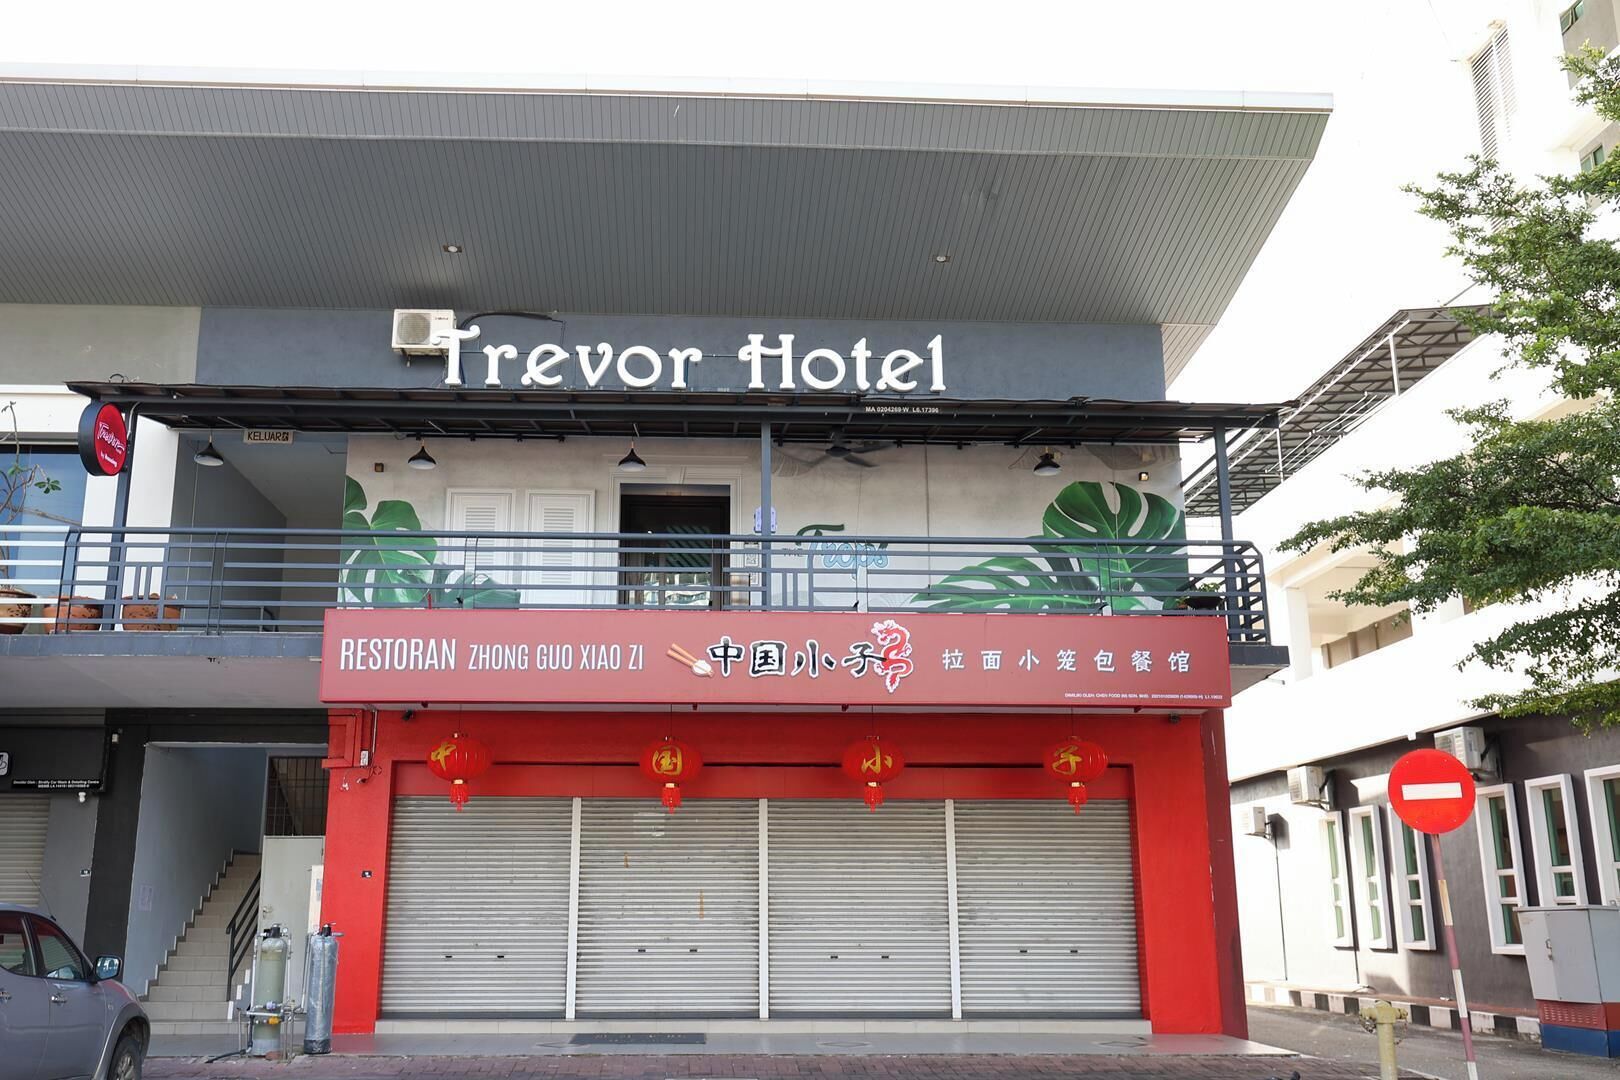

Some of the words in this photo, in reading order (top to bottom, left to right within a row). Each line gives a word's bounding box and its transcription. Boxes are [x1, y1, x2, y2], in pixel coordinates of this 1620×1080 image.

[431, 325, 703, 389] Trevor
[738, 333, 946, 392] Hotel
[247, 431, 282, 441] KELUAR
[339, 638, 457, 671] RESTORAN
[468, 644, 529, 671] ZHONG
[536, 644, 573, 670] GUO
[579, 644, 622, 670] XIAO
[628, 644, 644, 670] ZI
[707, 636, 887, 677] 中国小子
[942, 648, 1191, 673] 拉面小笼包餐馆
[652, 745, 682, 775] 国
[861, 744, 893, 774] 小
[1052, 745, 1082, 775] 子
